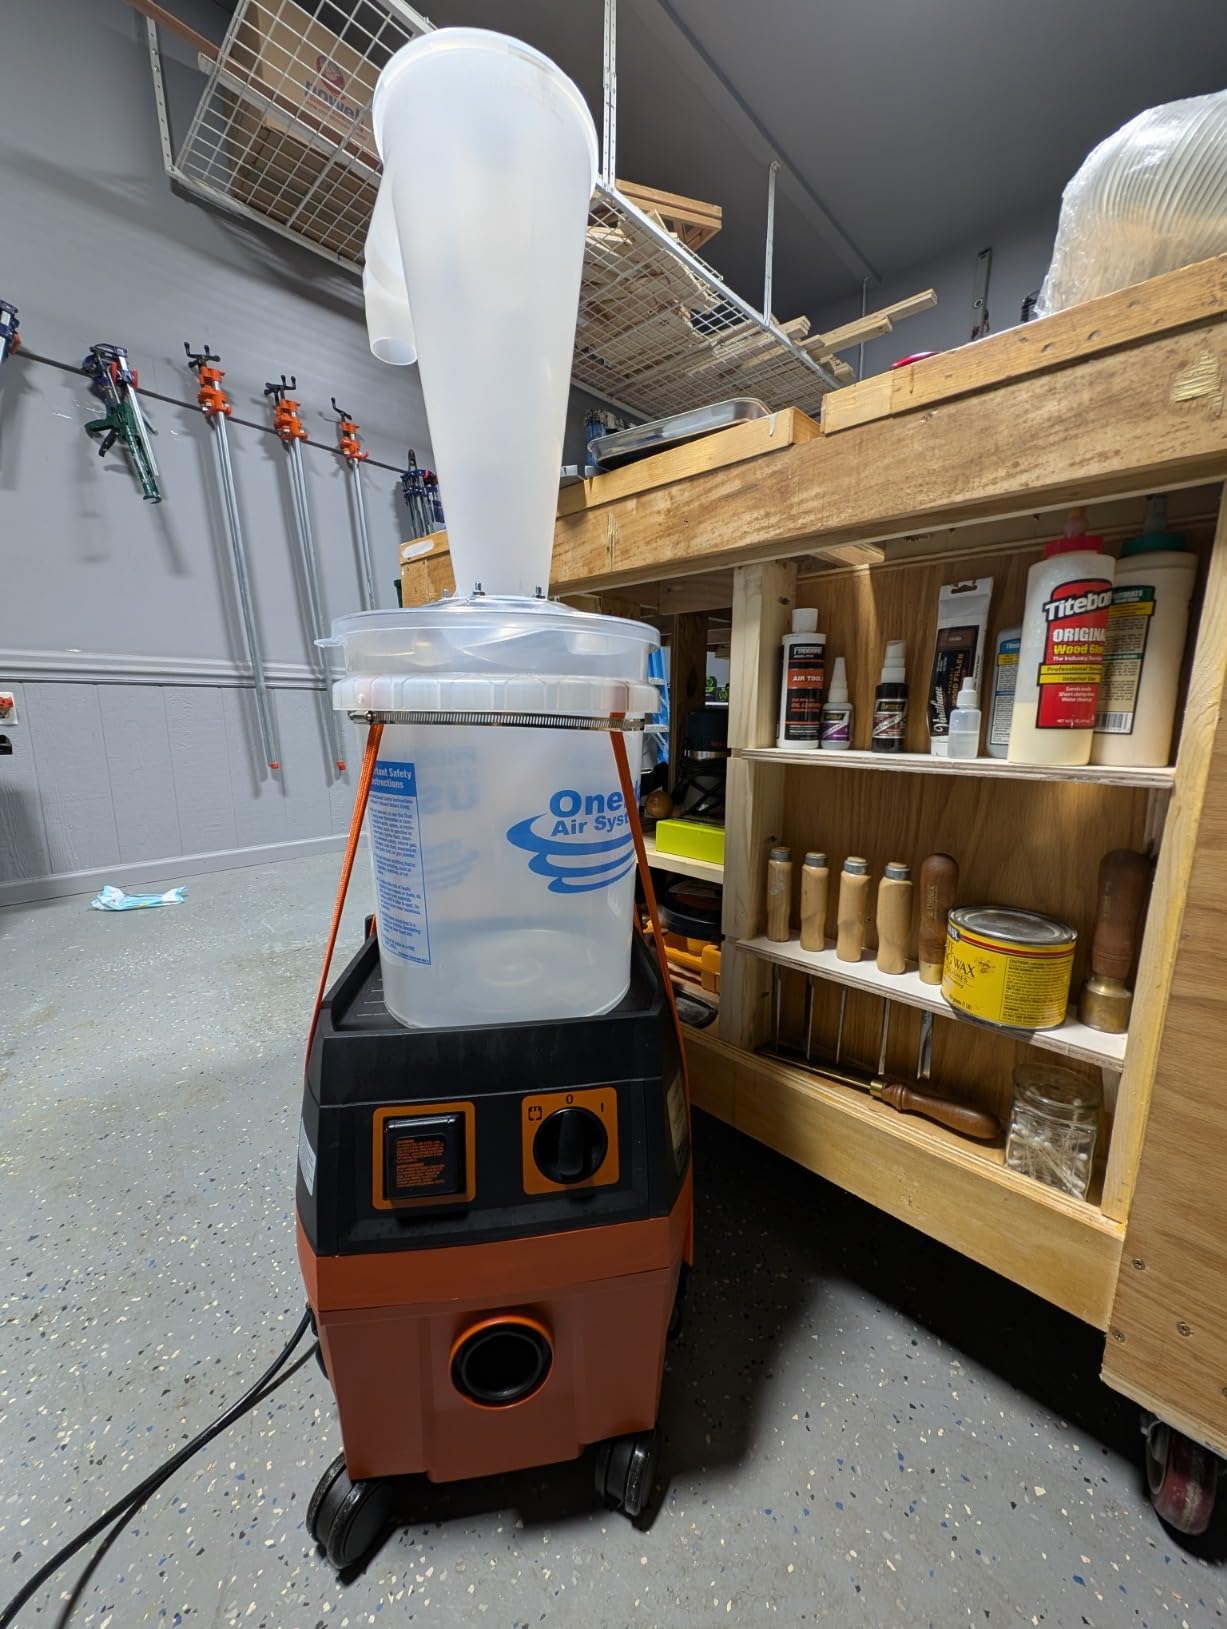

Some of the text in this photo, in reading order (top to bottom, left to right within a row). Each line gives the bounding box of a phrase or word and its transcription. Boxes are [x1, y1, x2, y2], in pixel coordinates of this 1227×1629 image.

[1054, 644, 1088, 655] Wood
[389, 767, 412, 780] Safety
[550, 789, 623, 818] One
[551, 813, 629, 836] Air Syst
[954, 957, 976, 978] WAX
